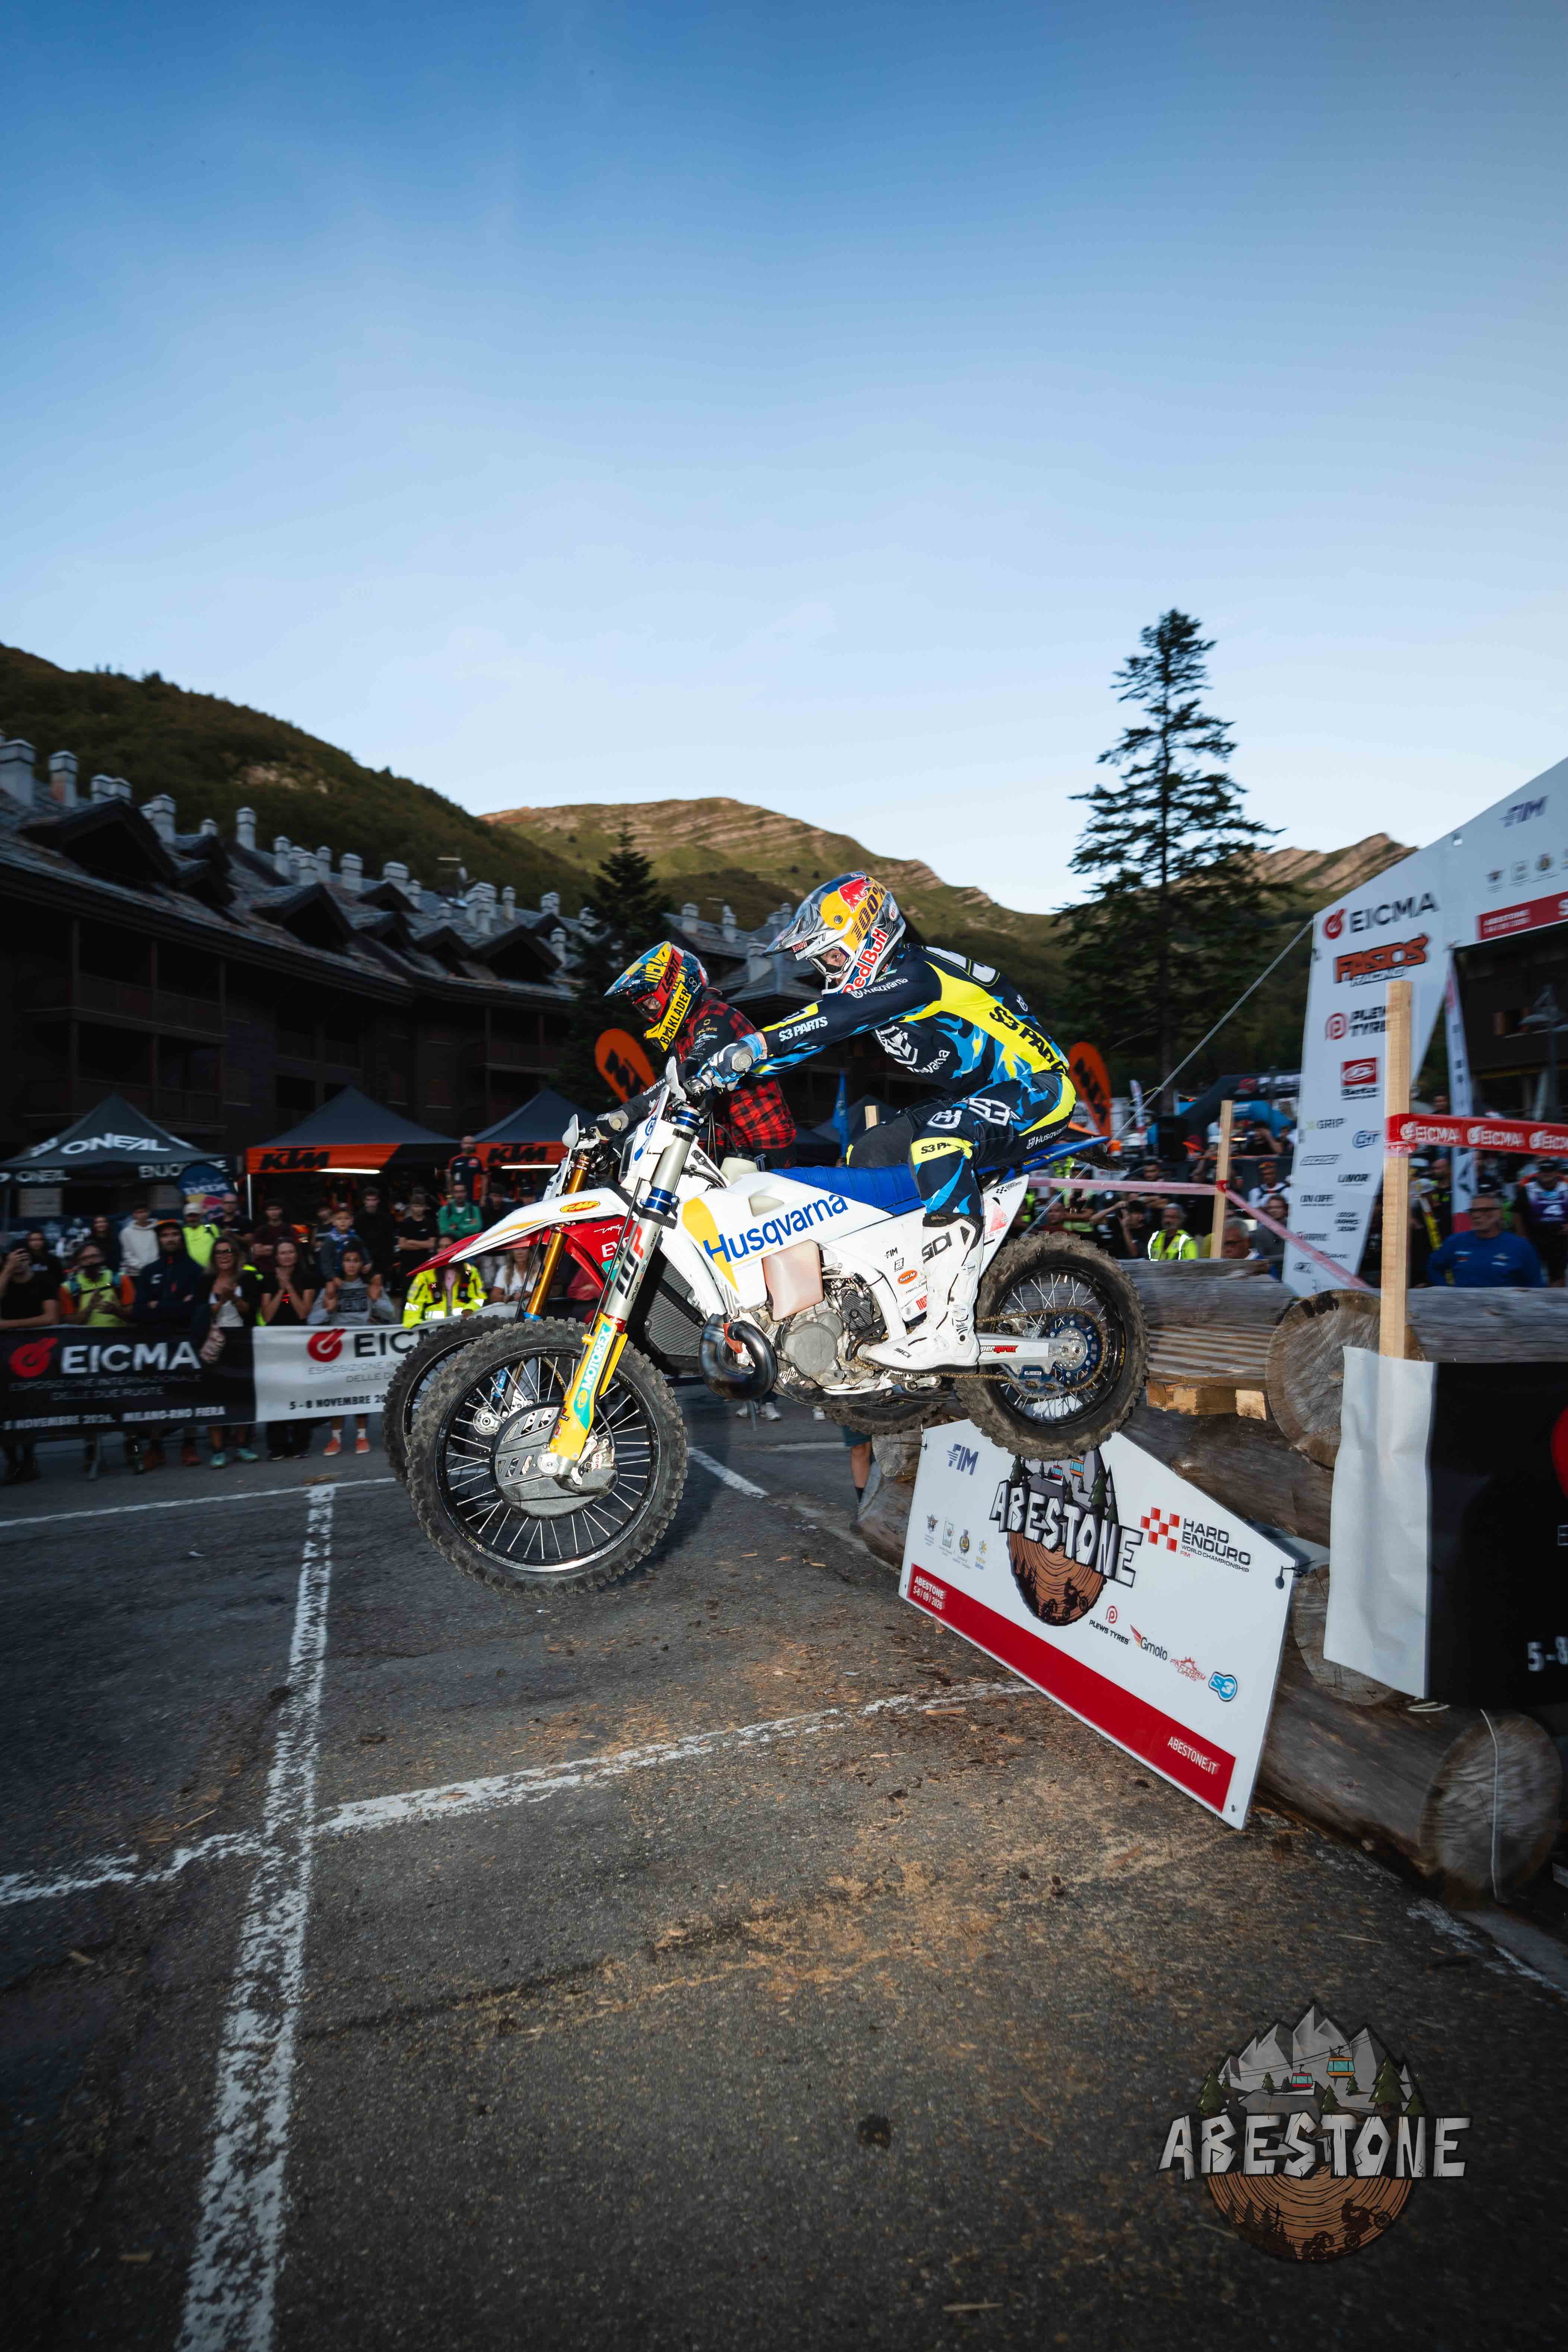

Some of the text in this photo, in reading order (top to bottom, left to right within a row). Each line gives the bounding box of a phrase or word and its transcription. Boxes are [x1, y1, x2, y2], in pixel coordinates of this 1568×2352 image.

[851, 886, 886, 943] 100%
[1349, 892, 1439, 933] EICMA
[779, 1016, 828, 1042] S3 PARTS
[989, 1006, 1020, 1031] S3
[1415, 1125, 1460, 1143] EICMA
[1481, 1130, 1525, 1147] EICMA
[1542, 1134, 1568, 1150] EIC
[260, 1147, 331, 1170] KTM
[487, 1143, 549, 1163] KTM
[921, 1144, 935, 1154] S3
[703, 1194, 848, 1263] Husqvarna
[906, 1281, 927, 1294] REKLUS
[61, 1341, 202, 1373] EICMA
[307, 1362, 385, 1375] ESPOSIZIONE
[581, 1325, 612, 1390] MOTOREX
[346, 1372, 381, 1383] DELLE
[315, 1395, 370, 1408] NOVEMBRE
[374, 1394, 386, 1403] 20
[947, 1443, 979, 1476] FIM
[989, 1479, 1144, 1588] ABESTONE
[1183, 1518, 1229, 1544] HARD
[1181, 1545, 1249, 1573] WORLD CHAMPIONSHIP
[1182, 1531, 1251, 1566] ENDURO
[914, 1576, 946, 1599] ABESTONE
[1089, 1619, 1129, 1645] PLEWS TYRES
[1140, 1637, 1168, 1661] Gmoto
[1169, 1658, 1206, 1681] FACTORY
[1167, 1736, 1218, 1775] ABESTONE.IT
